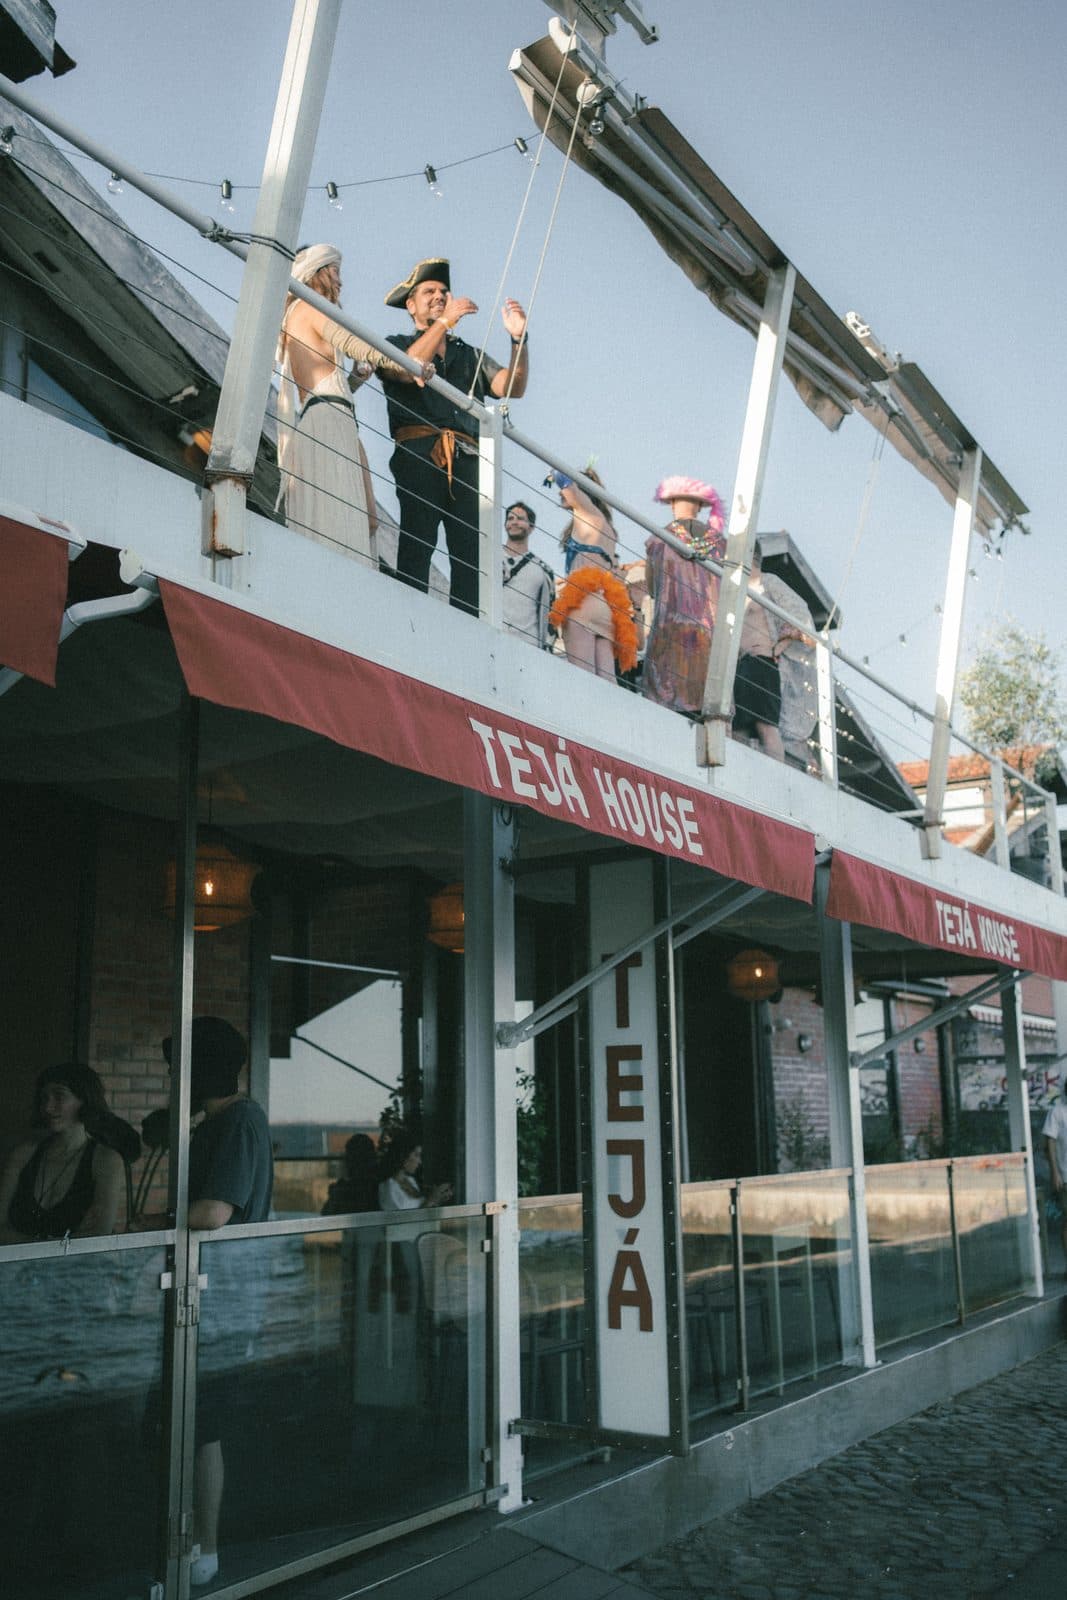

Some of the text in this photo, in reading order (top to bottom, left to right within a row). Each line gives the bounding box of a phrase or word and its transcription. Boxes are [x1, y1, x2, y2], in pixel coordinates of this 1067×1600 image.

[469, 717, 703, 856] TEJÁ HOUSE
[936, 900, 977, 950] TEJÁ
[601, 952, 653, 1332] TEJÁ
